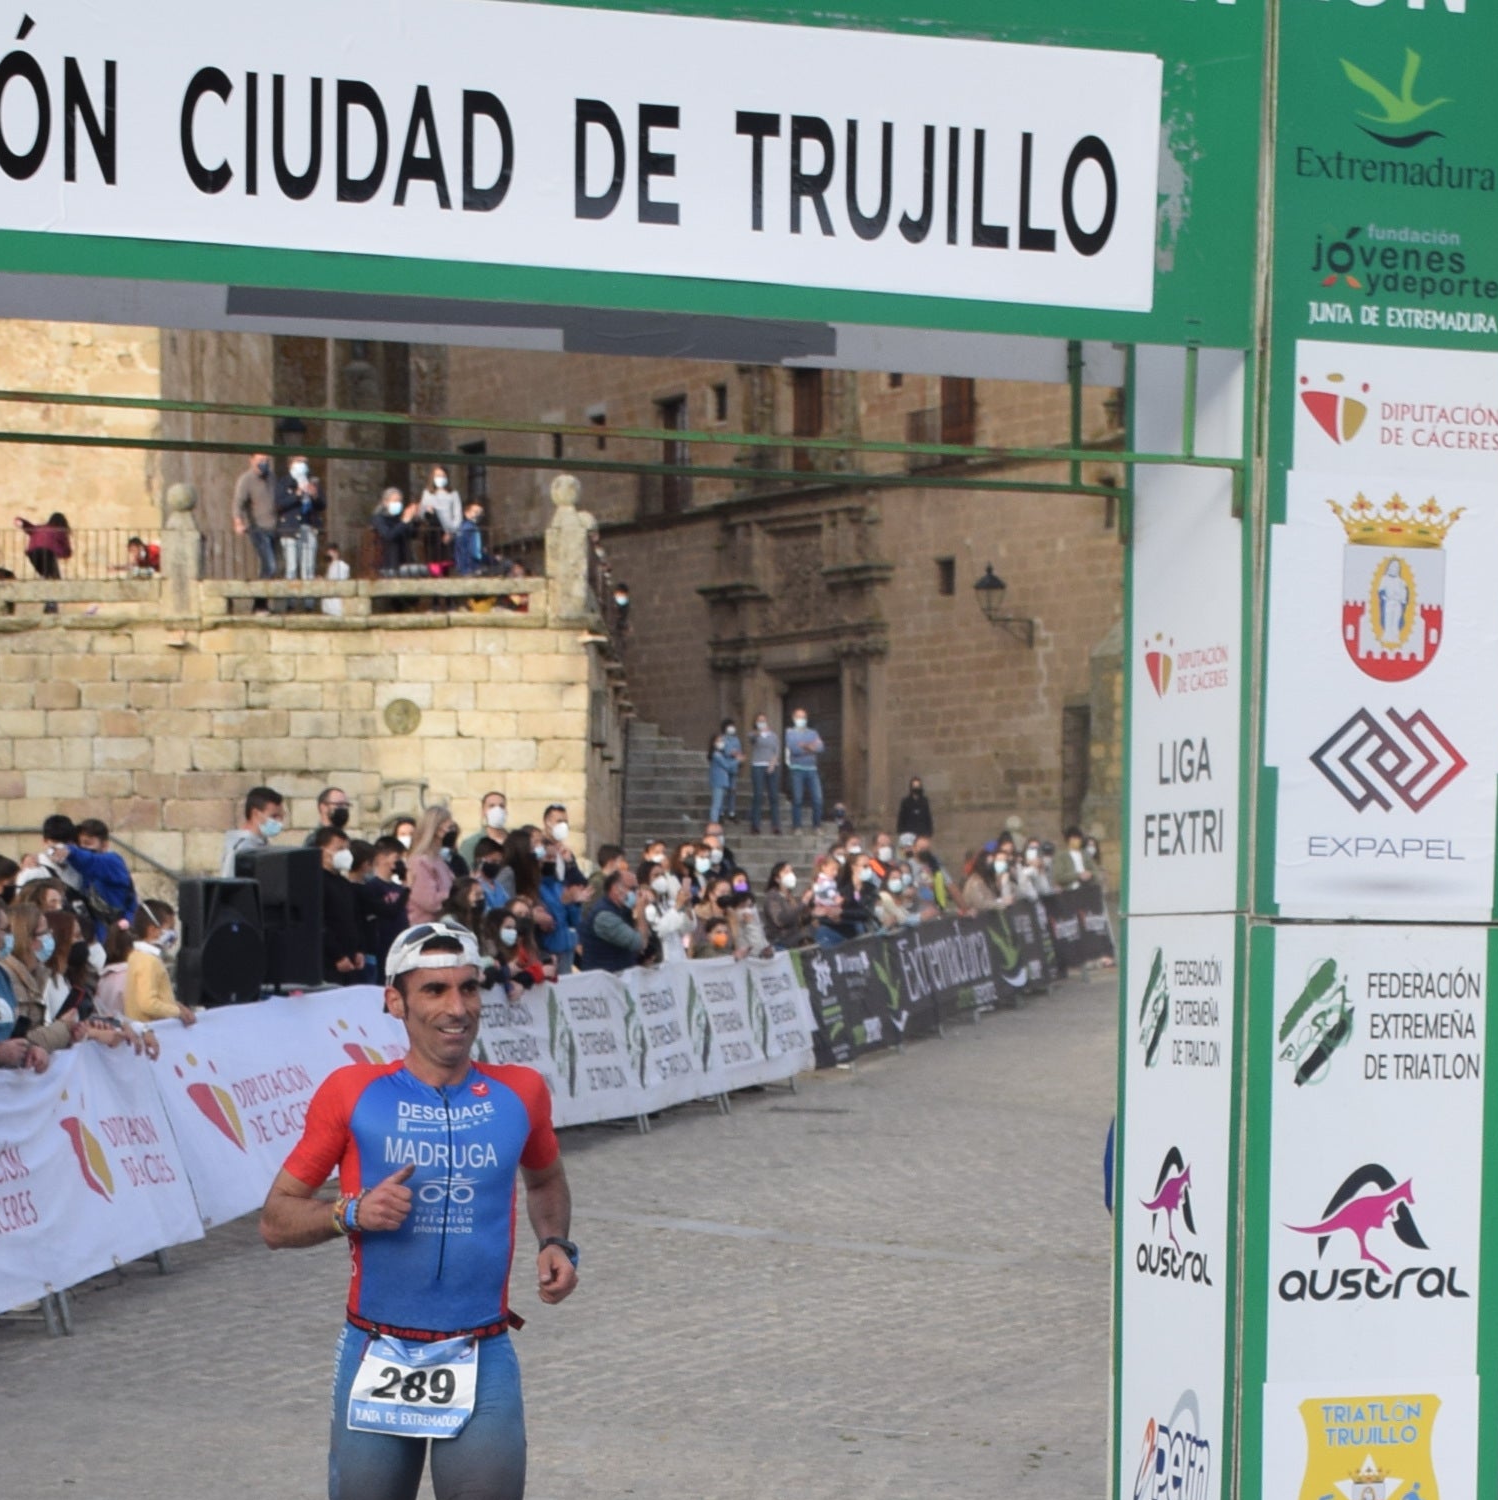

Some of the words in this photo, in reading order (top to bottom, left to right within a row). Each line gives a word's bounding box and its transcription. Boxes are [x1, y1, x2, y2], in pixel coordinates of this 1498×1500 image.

[180, 66, 514, 213] CIUDAD
[574, 98, 680, 226] DE
[735, 110, 1118, 257] TRUJILLO
[1296, 146, 1496, 192] Extremadura
[1311, 226, 1467, 275] jóvenes
[1367, 223, 1461, 246] fundación
[1309, 301, 1353, 325] JUNTA
[1360, 305, 1379, 326] DE
[1386, 307, 1498, 334] EXTREMADURA
[1380, 426, 1404, 445] DE
[1158, 737, 1212, 784] LIGA
[1144, 808, 1224, 857] FEXTRI
[1308, 836, 1466, 860] EXPAPEL
[897, 920, 993, 1002] Extremadura
[1174, 954, 1222, 987] FEDERACIÓN
[1368, 967, 1481, 999] FEDERACIÓN
[1174, 995, 1219, 1028] EXTREMEÑA
[1370, 1008, 1477, 1040] EXTREMEÑA
[1172, 1040, 1185, 1067] DE
[1365, 1054, 1389, 1080] DE
[232, 1063, 313, 1109] DIPUTACIÓN
[398, 1100, 495, 1121] DESGUACE
[385, 1136, 498, 1168] MADRUGA
[413, 1223, 474, 1234] plasencia
[1136, 1243, 1213, 1287] austral
[1278, 1266, 1471, 1301] austral
[371, 1366, 456, 1405] 289
[355, 1407, 381, 1422] JUNTA
[385, 1411, 397, 1425] DE
[401, 1411, 464, 1427] EXTREMADURA
[1321, 1401, 1422, 1423] TRIATLÓN
[1324, 1424, 1418, 1447] TRUJILLO
